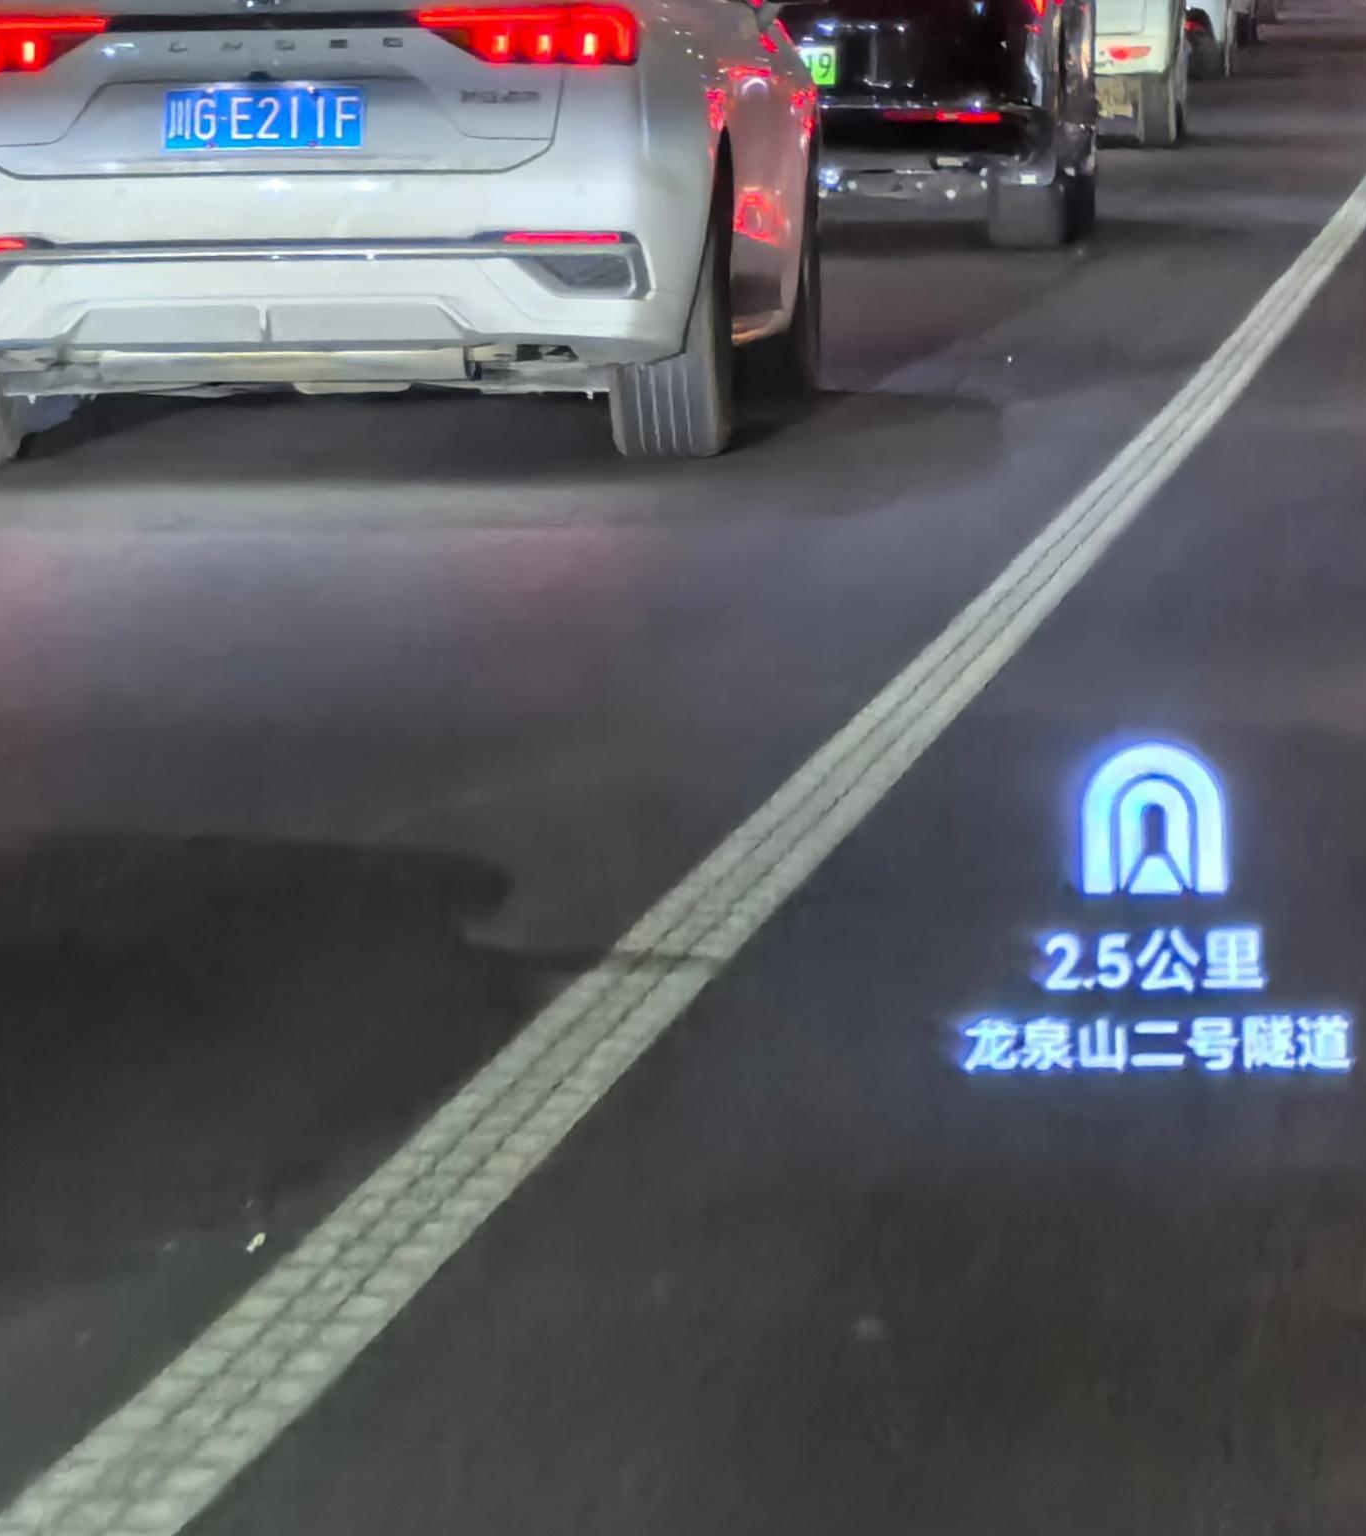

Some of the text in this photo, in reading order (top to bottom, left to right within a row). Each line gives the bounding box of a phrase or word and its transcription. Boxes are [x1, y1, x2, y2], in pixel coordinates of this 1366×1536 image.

[1043, 927, 1265, 993] 2.5公里
[961, 1014, 1354, 1072] 龙泉山二号隧道
